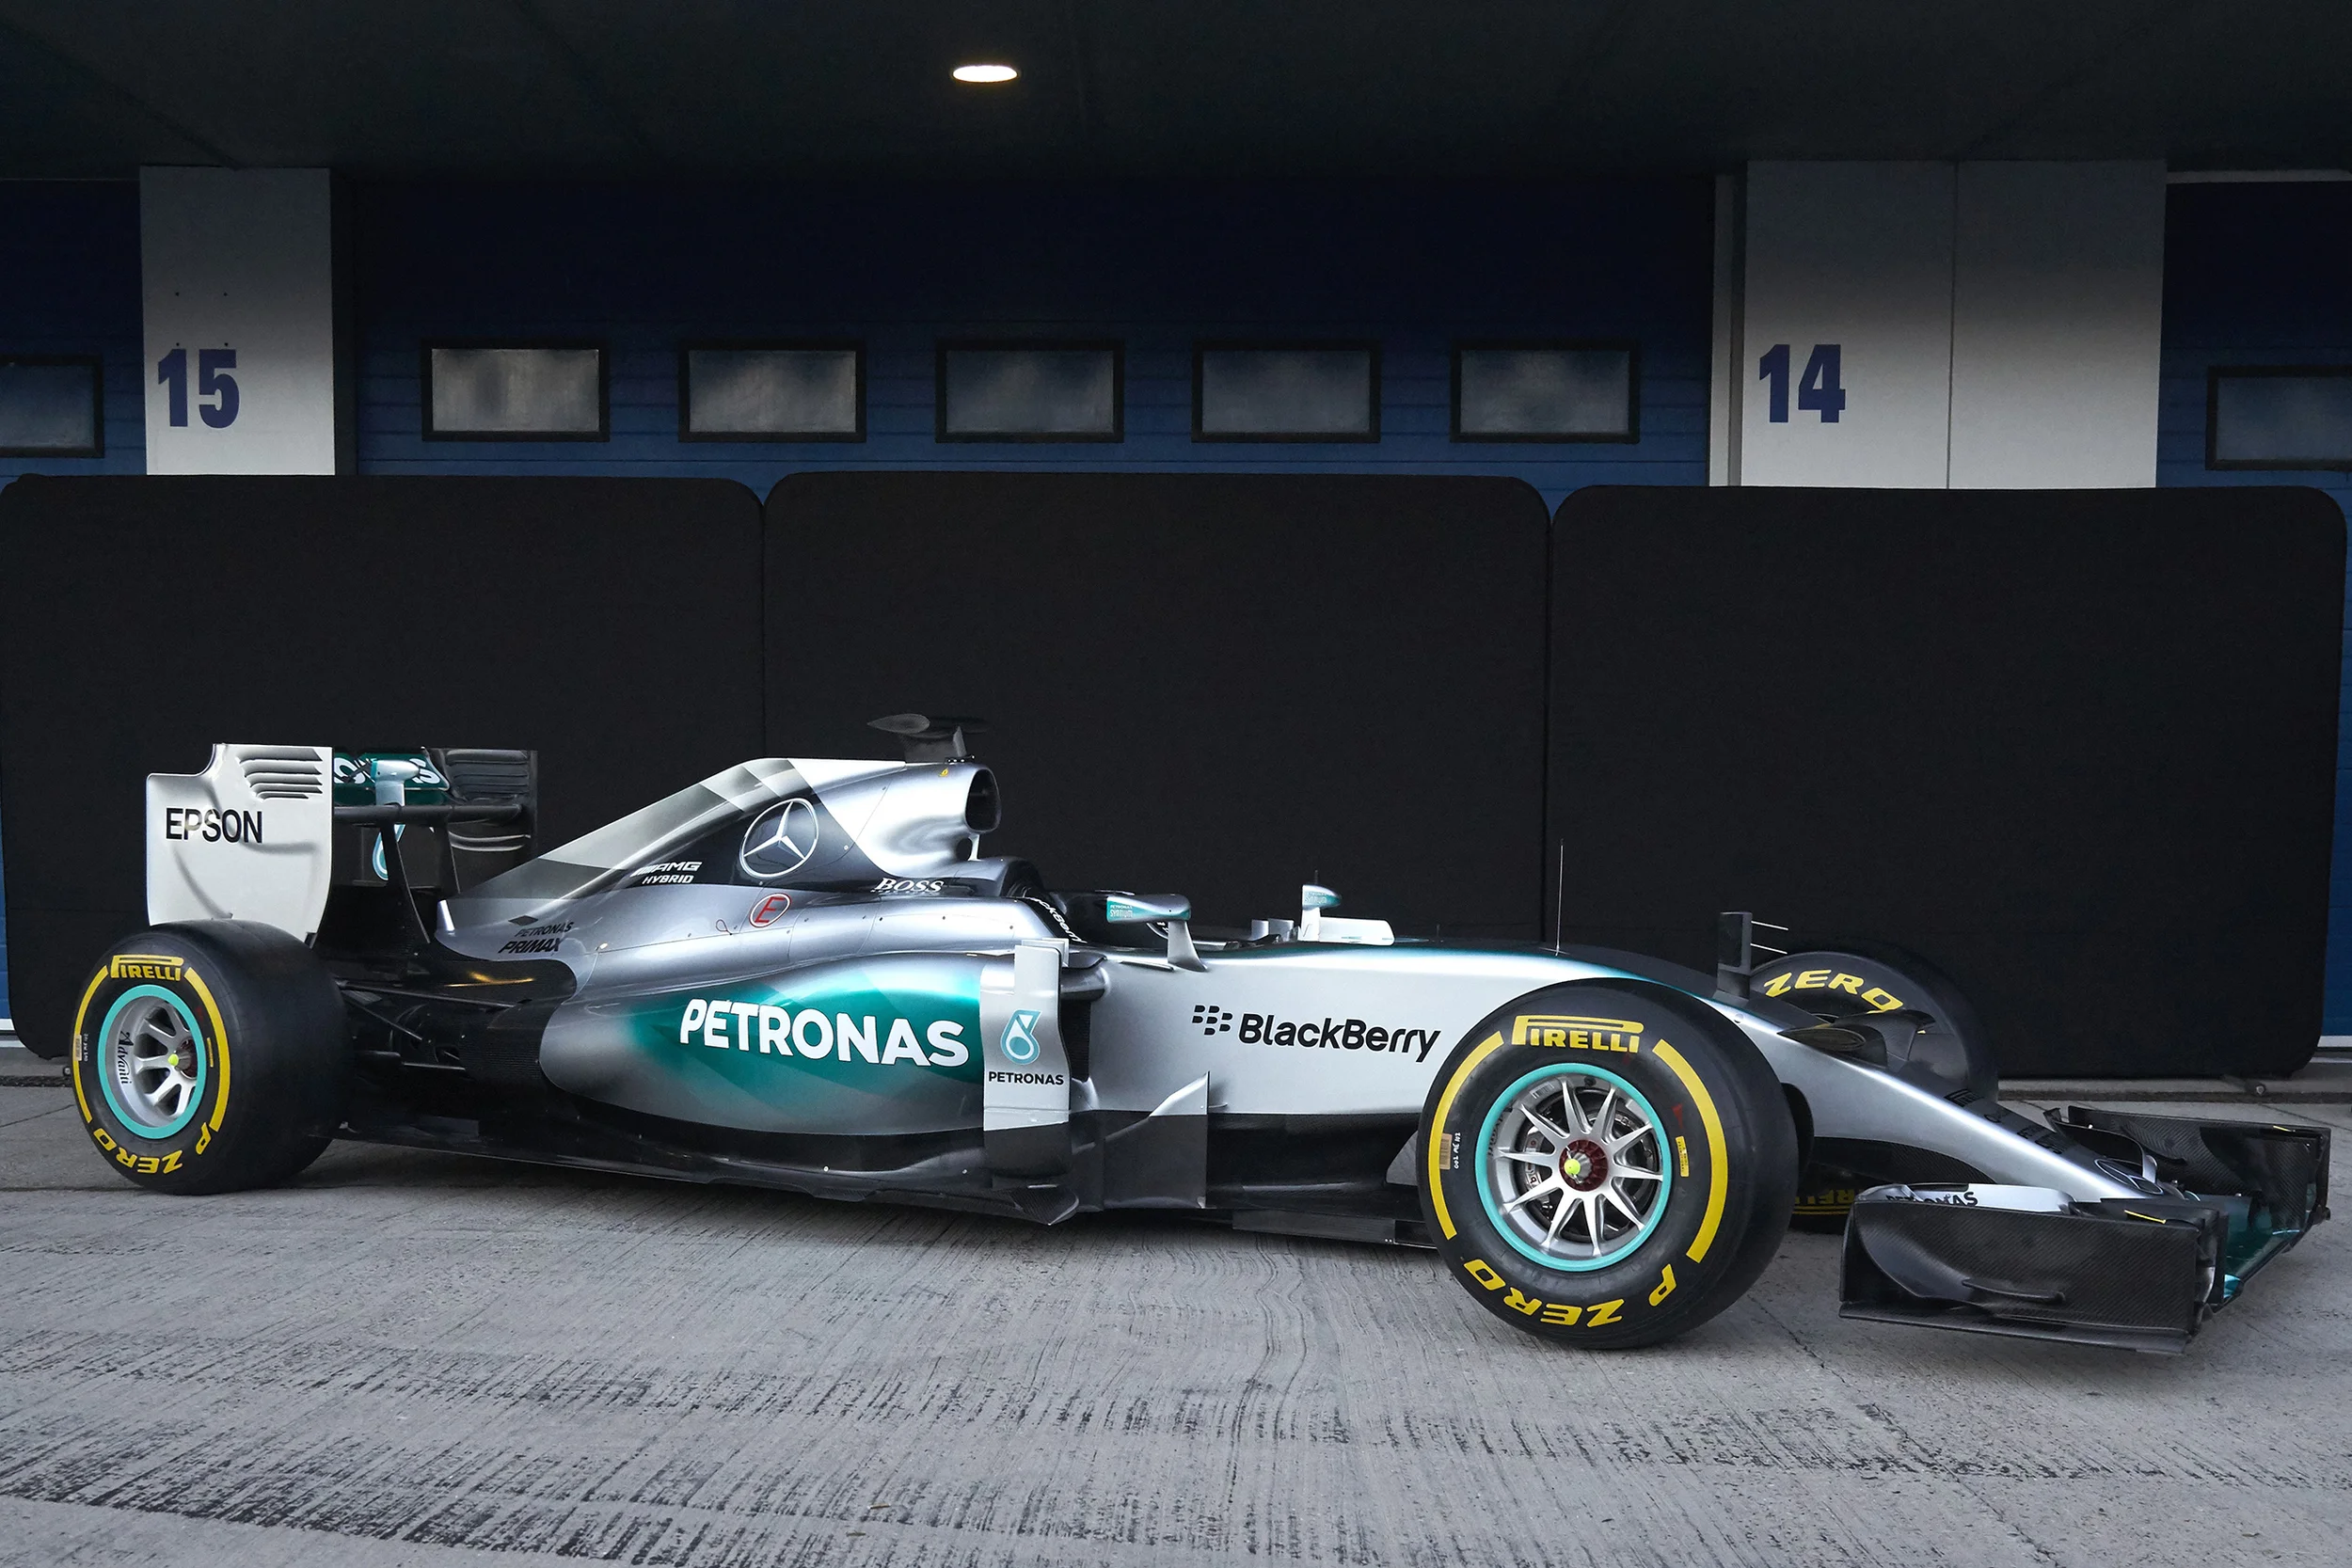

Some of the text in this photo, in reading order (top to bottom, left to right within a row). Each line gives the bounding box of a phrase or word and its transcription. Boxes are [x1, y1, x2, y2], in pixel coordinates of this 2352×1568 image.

[158, 349, 240, 429] 15
[1759, 344, 1846, 423] 14
[166, 807, 262, 843] EPSON
[642, 875, 694, 884] HYBRID
[874, 877, 945, 893] BOSS
[498, 938, 562, 954] PRIMAX
[515, 922, 574, 937] PETRONAS
[110, 954, 184, 981] PIRELLI
[1763, 969, 1903, 1012] ZERO
[679, 998, 969, 1068] PETRONAS
[1239, 1013, 1441, 1063] BlackBerry
[1511, 1014, 1645, 1053] PIRELLI
[118, 1030, 135, 1085] Advanti
[988, 1070, 1064, 1085] PETRONAS
[93, 1122, 212, 1174] P ZERO
[1463, 1259, 1677, 1328] P ZERO
